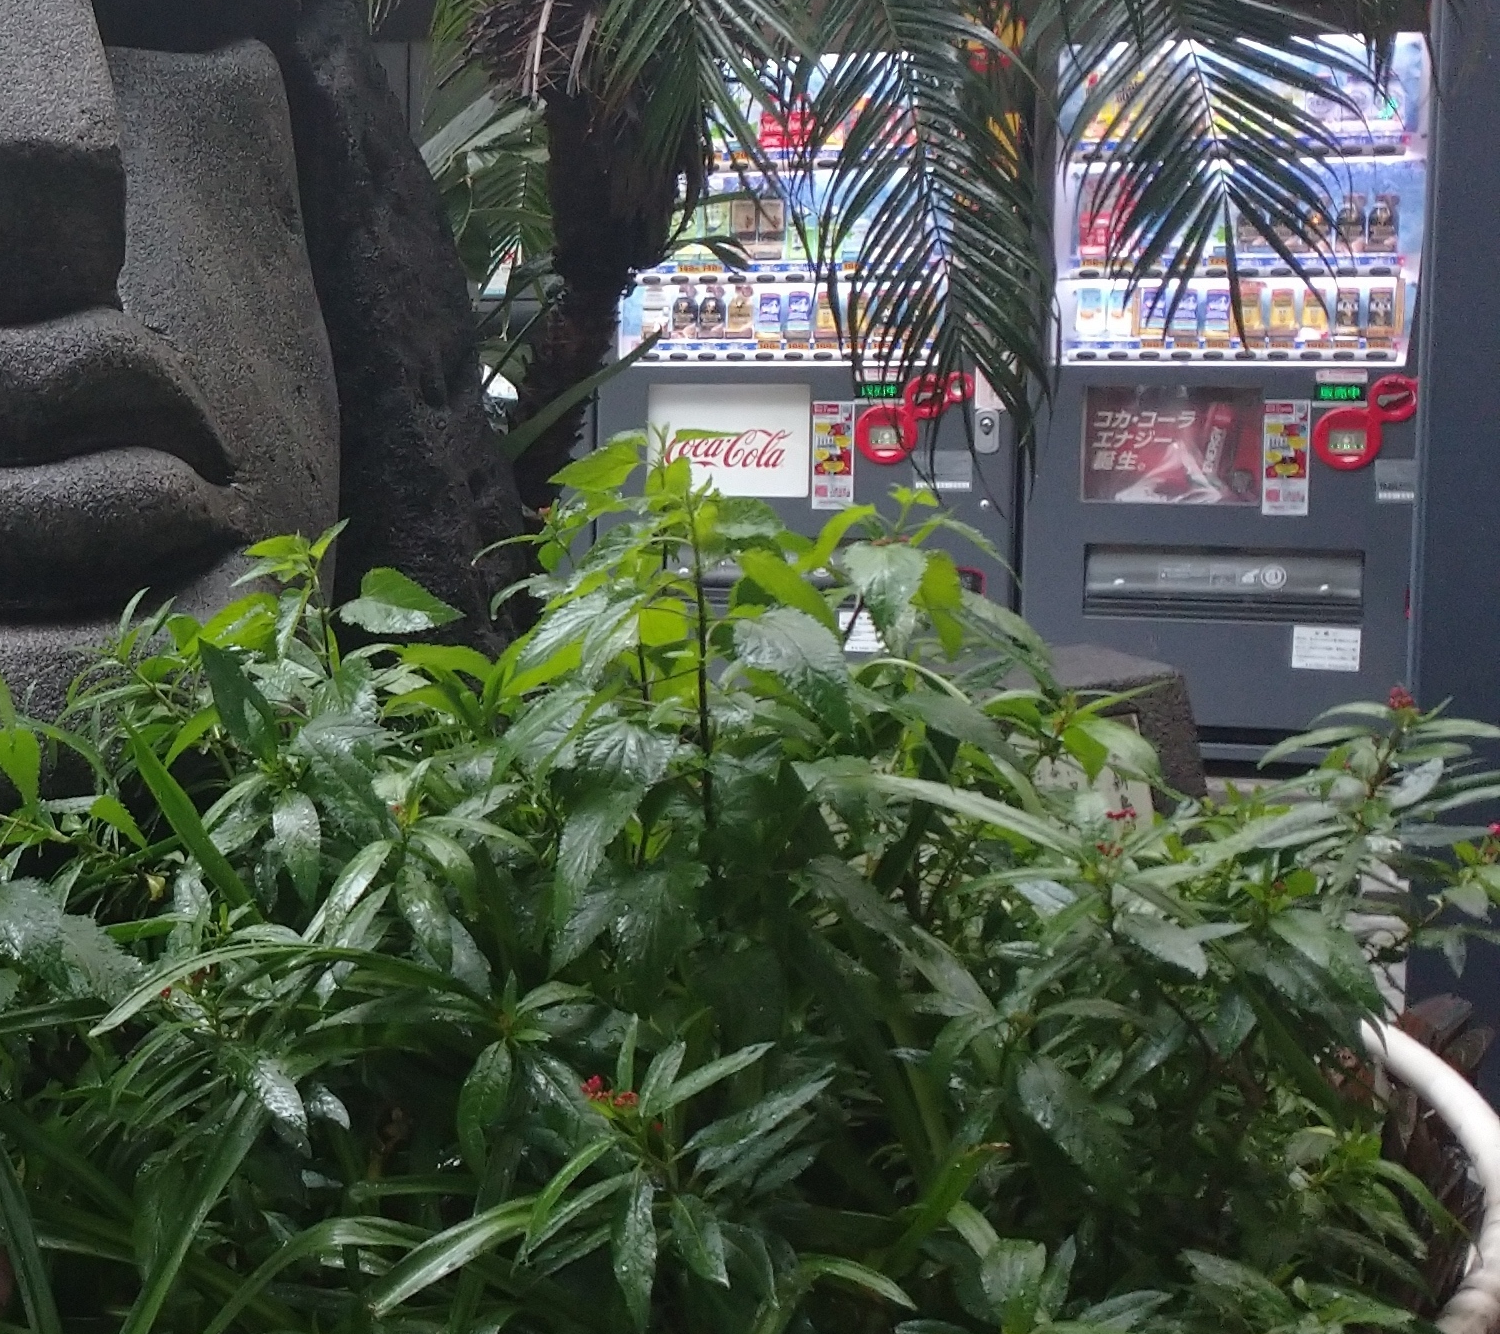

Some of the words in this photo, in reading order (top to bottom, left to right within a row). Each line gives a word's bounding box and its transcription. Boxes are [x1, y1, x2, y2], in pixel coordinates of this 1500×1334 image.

[1093, 409, 1197, 429] コカ・コーラ
[1091, 430, 1173, 449] エナジー
